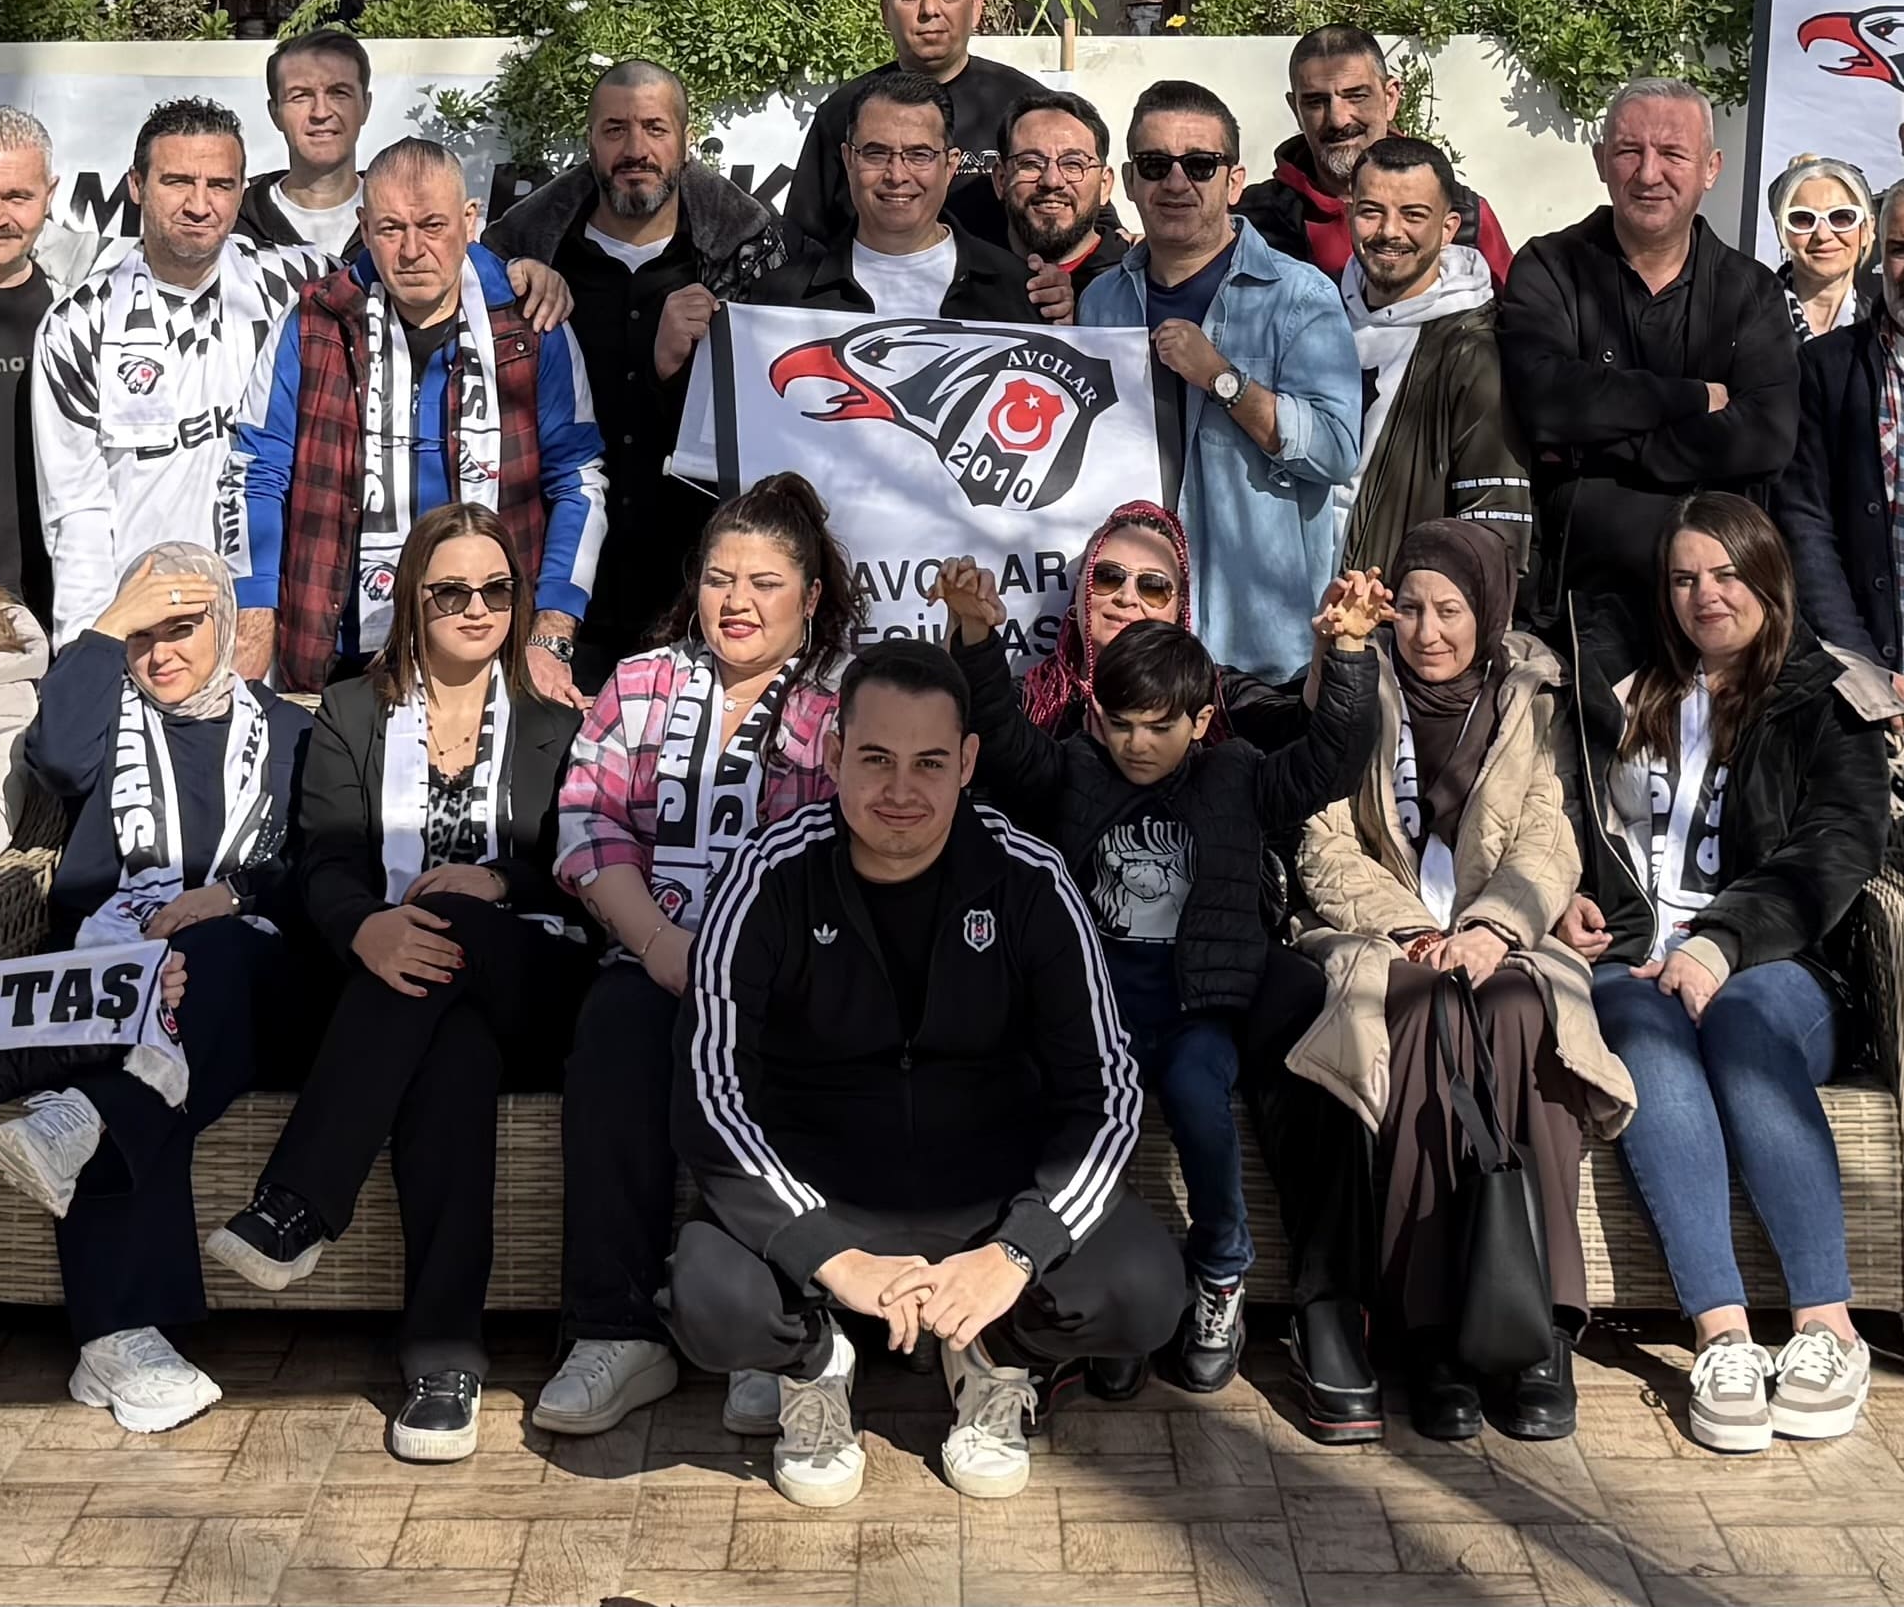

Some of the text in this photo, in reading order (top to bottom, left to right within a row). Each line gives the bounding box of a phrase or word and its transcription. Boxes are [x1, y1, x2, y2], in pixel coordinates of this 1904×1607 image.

[1006, 349, 1099, 407] AVCILAR
[949, 442, 1033, 504] 2010
[853, 551, 1068, 602] AVCAR
